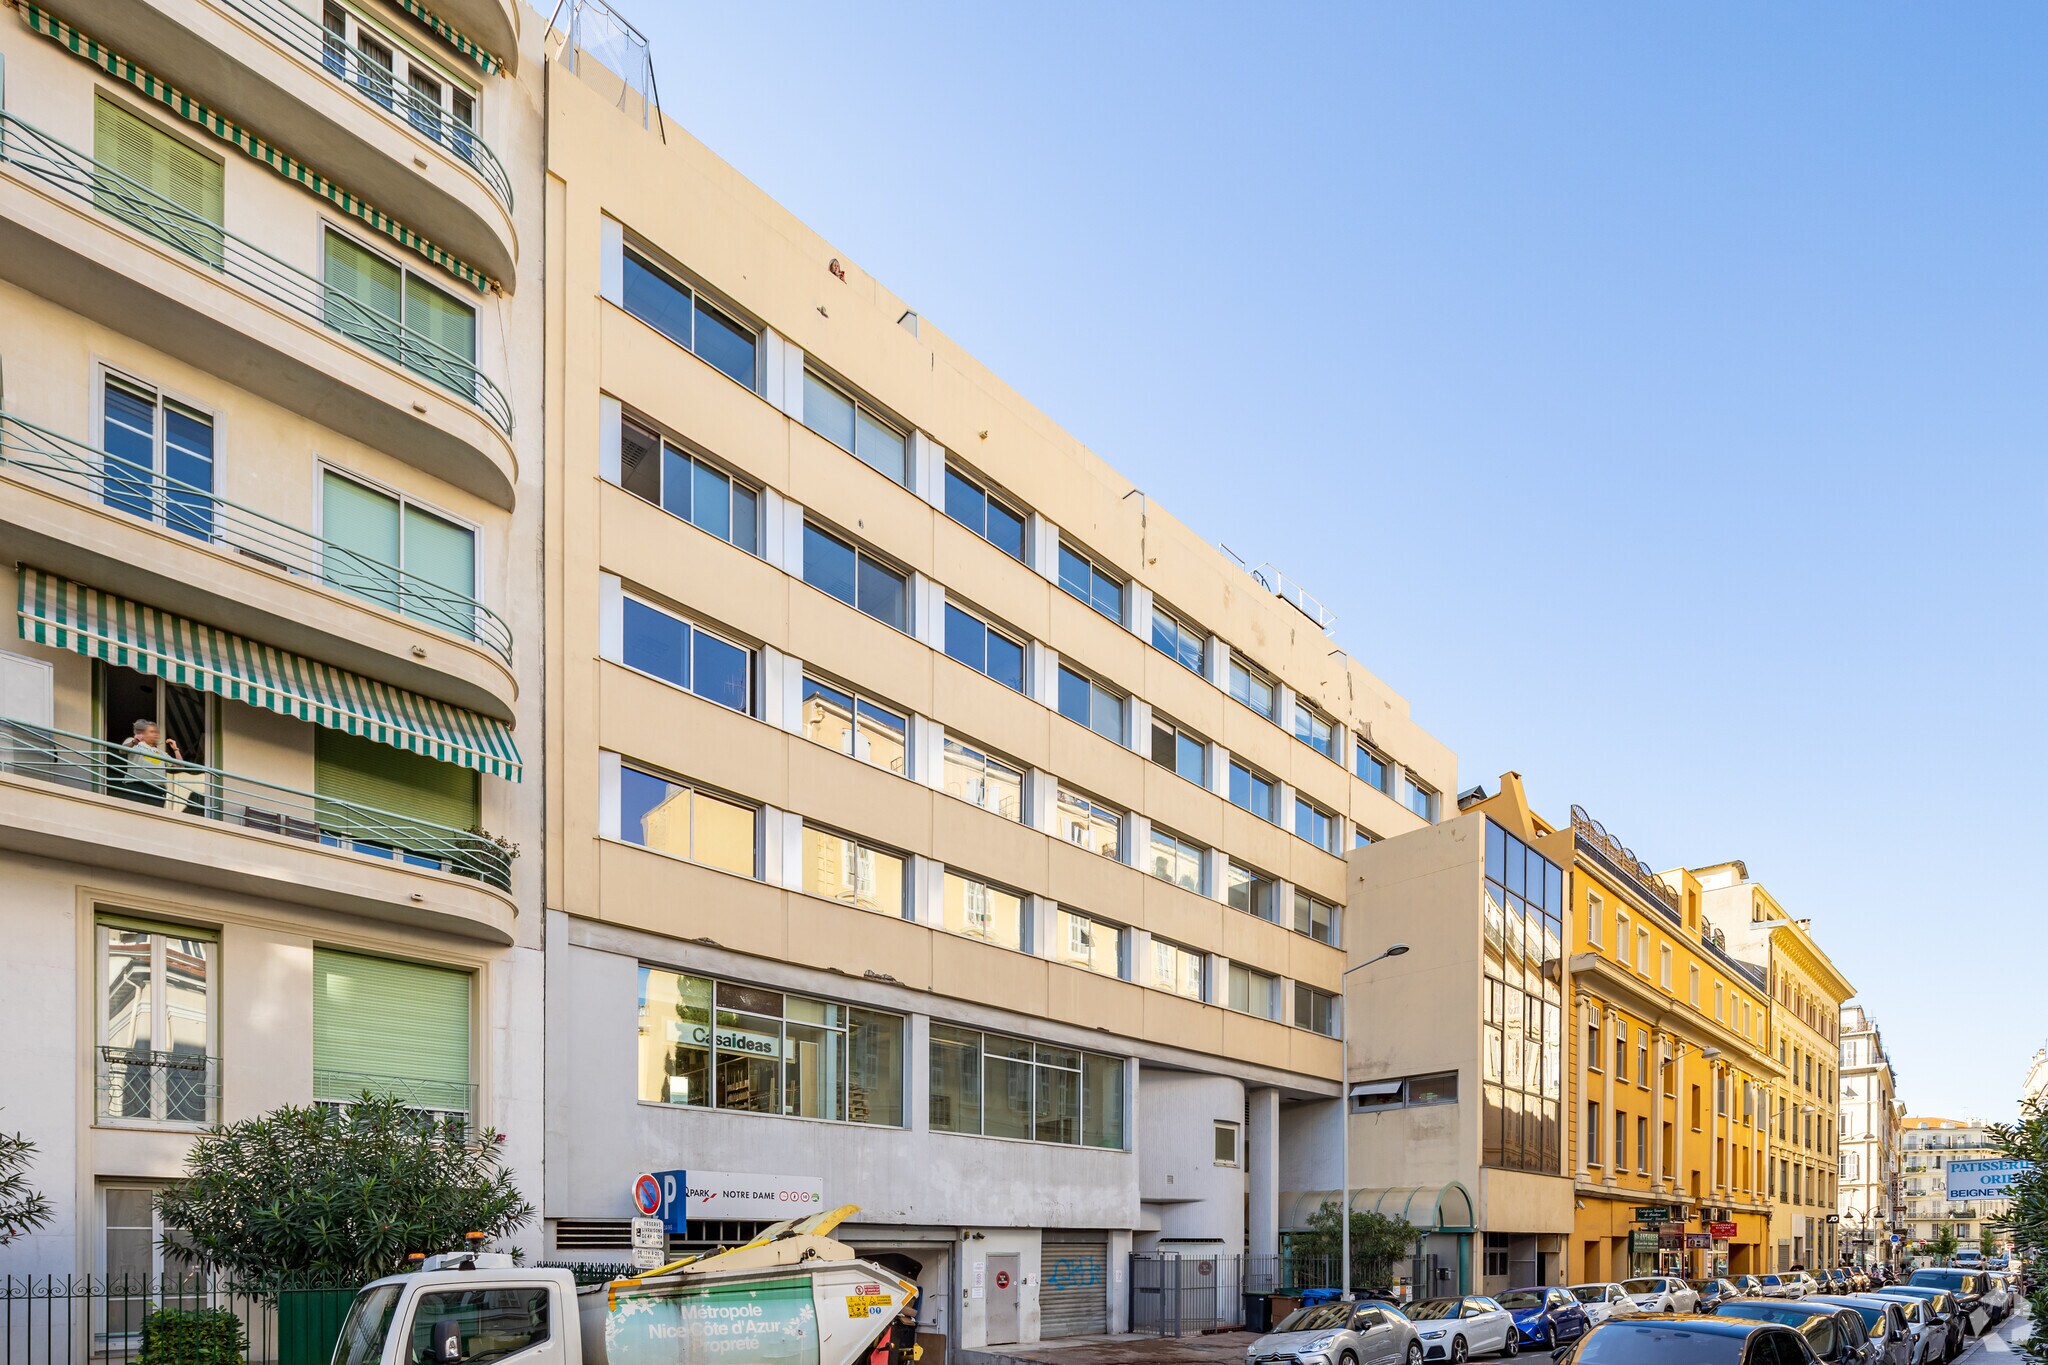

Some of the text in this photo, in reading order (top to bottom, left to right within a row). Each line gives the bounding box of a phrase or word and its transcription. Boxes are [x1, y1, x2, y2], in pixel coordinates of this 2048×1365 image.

[693, 1027, 772, 1053] Casaideas
[664, 1175, 677, 1219] P
[723, 1190, 749, 1199] NOTRE
[752, 1191, 775, 1200] DAME
[681, 1303, 763, 1320] Métropole
[648, 1319, 781, 1339] Nice Côte d'Azur
[691, 1335, 760, 1354] Propreté
